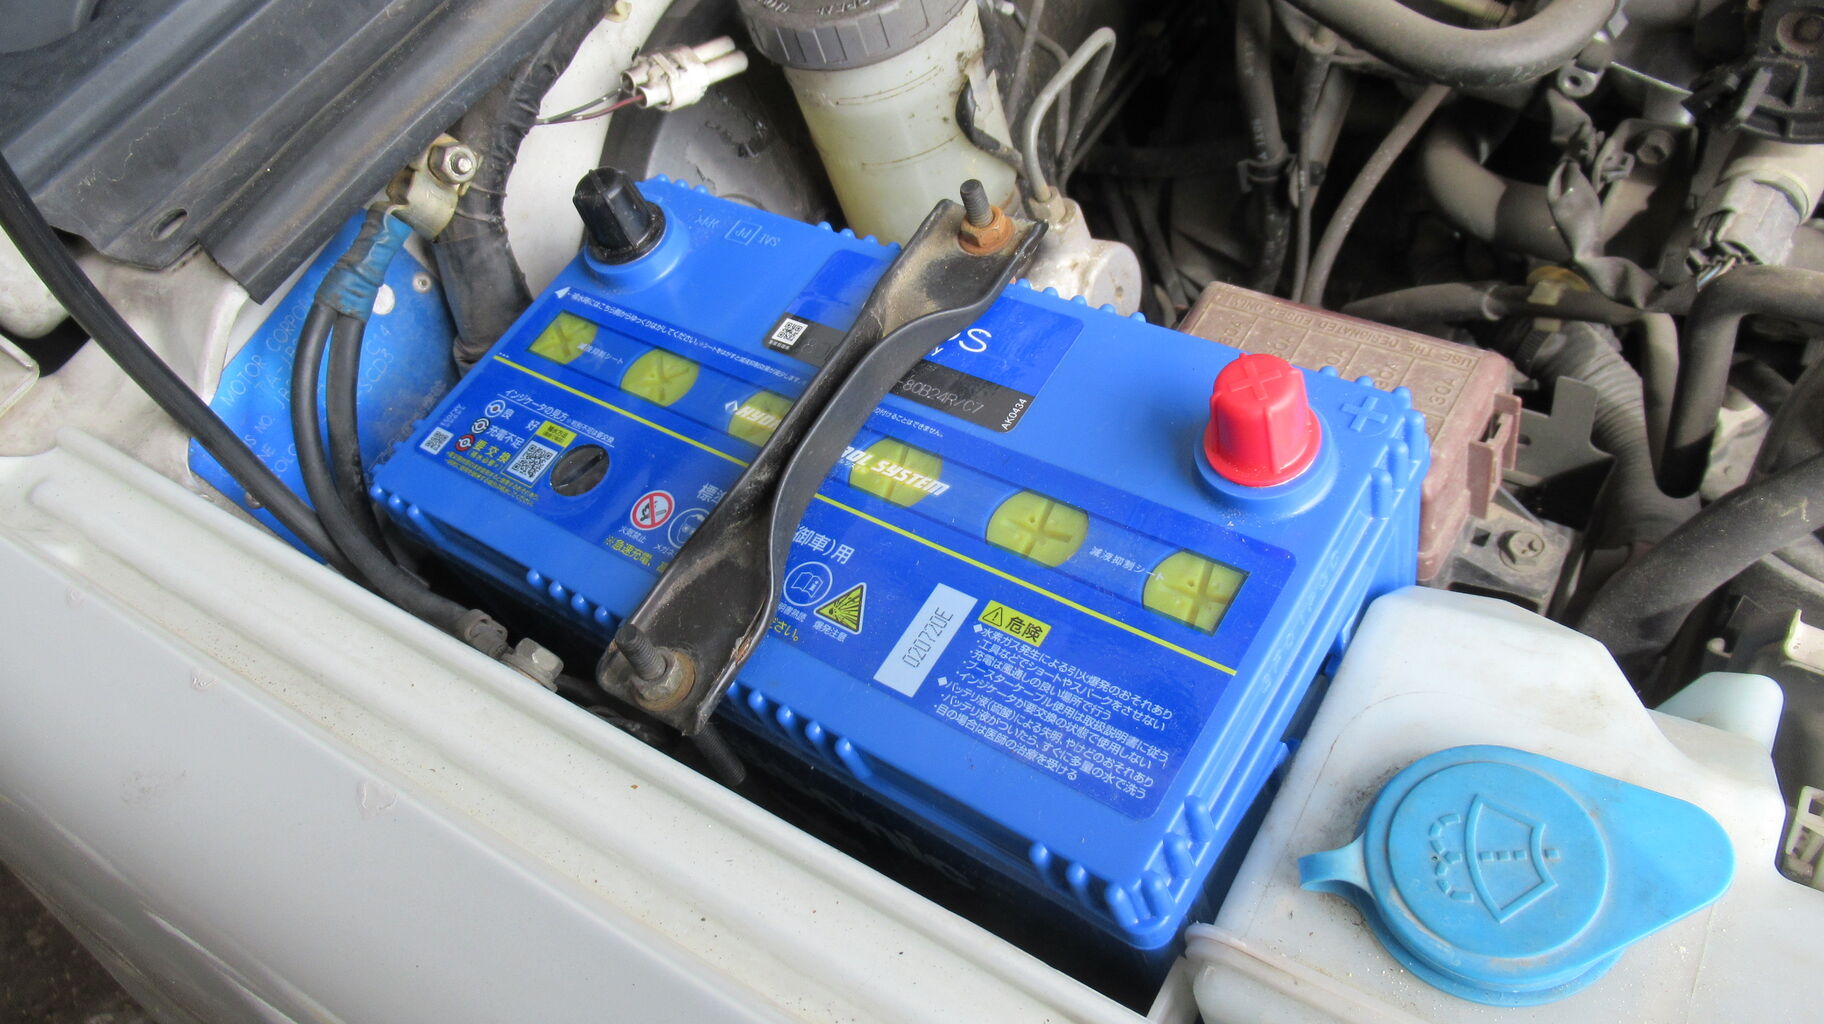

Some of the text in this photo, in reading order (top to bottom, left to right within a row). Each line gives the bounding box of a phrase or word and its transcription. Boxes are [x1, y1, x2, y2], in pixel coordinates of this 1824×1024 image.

[220, 354, 268, 407] MOTOR
[505, 389, 570, 422] インジケータの見方
[1001, 397, 1028, 431] AK0434
[486, 424, 525, 449] 充電不足
[870, 459, 951, 496] SYSTEM
[1088, 545, 1165, 580] 減液抑制シート
[812, 620, 849, 644] 爆発注意
[1005, 616, 1043, 643] 危険
